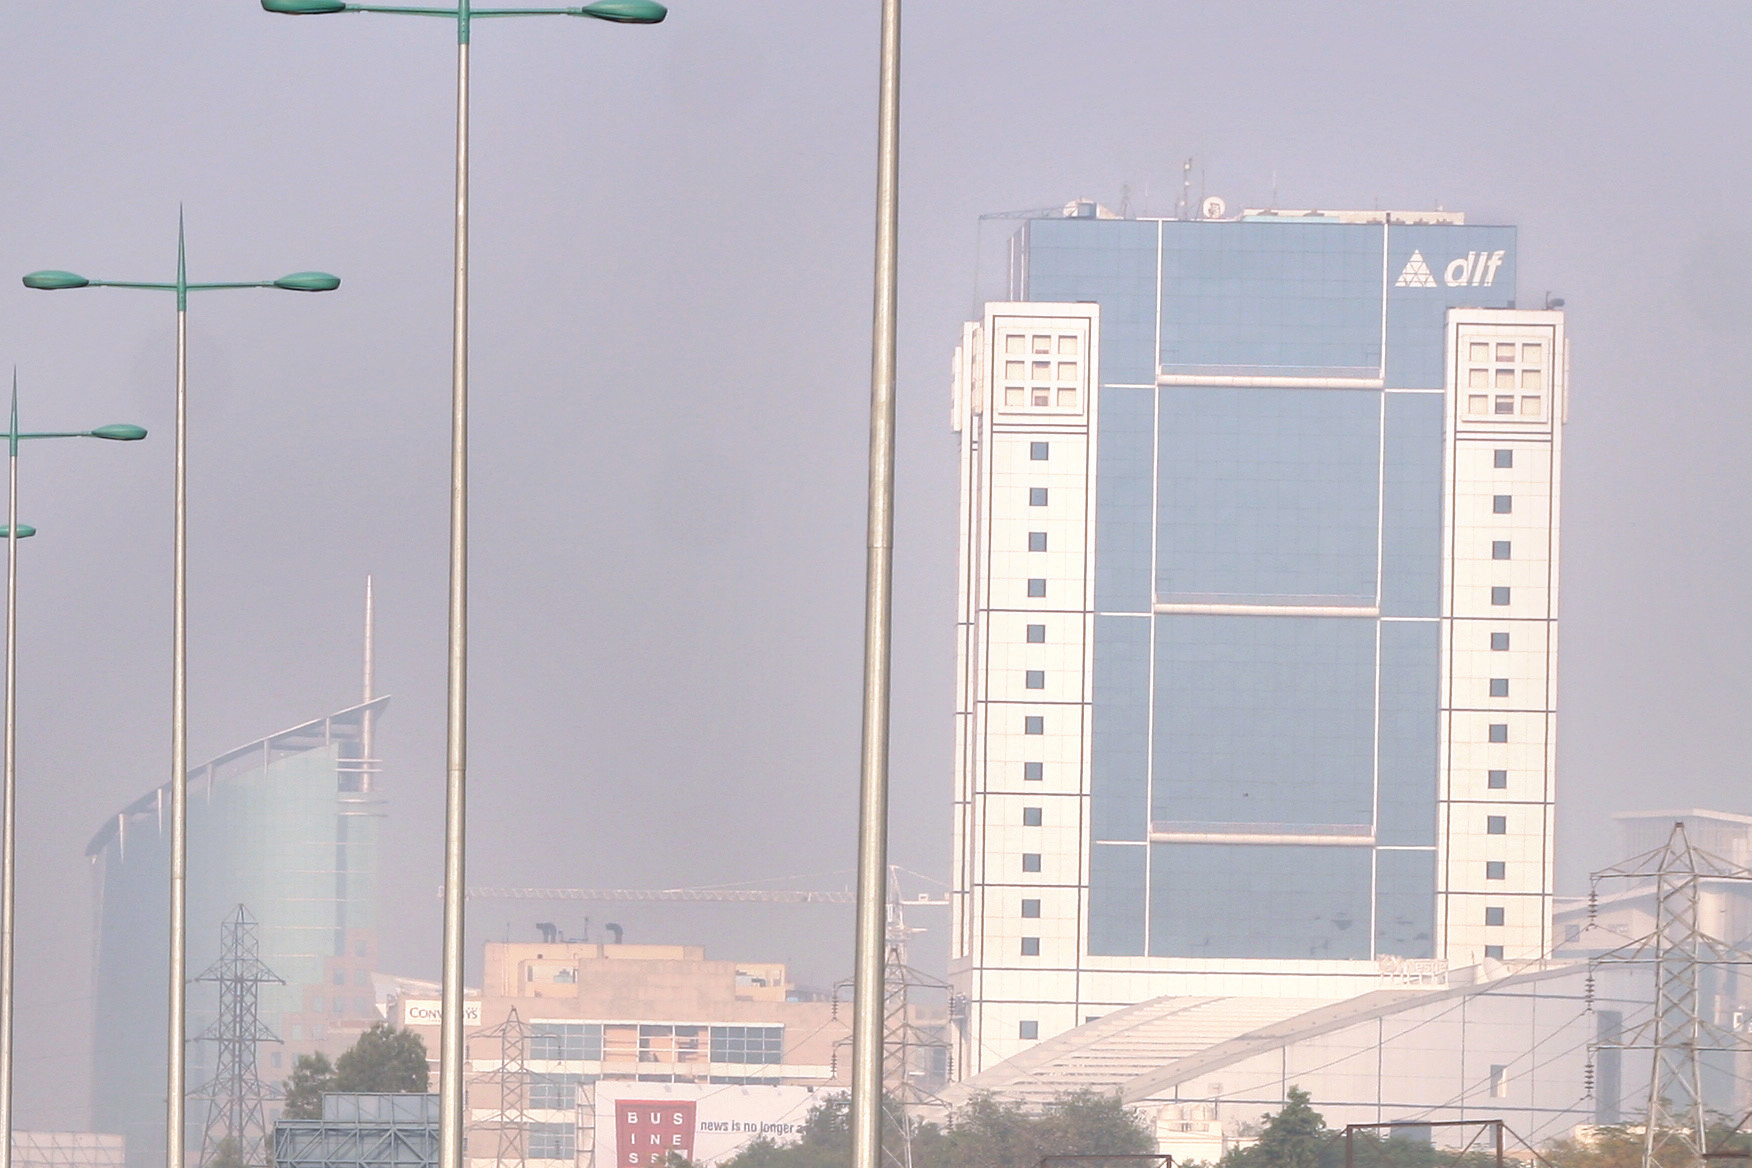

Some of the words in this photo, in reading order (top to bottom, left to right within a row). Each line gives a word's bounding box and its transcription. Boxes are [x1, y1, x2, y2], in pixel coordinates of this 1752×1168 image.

[1444, 250, 1505, 287] dlf
[700, 1120, 729, 1131] news
[731, 1120, 741, 1132] is
[744, 1122, 757, 1132] no
[760, 1121, 795, 1136] longer
